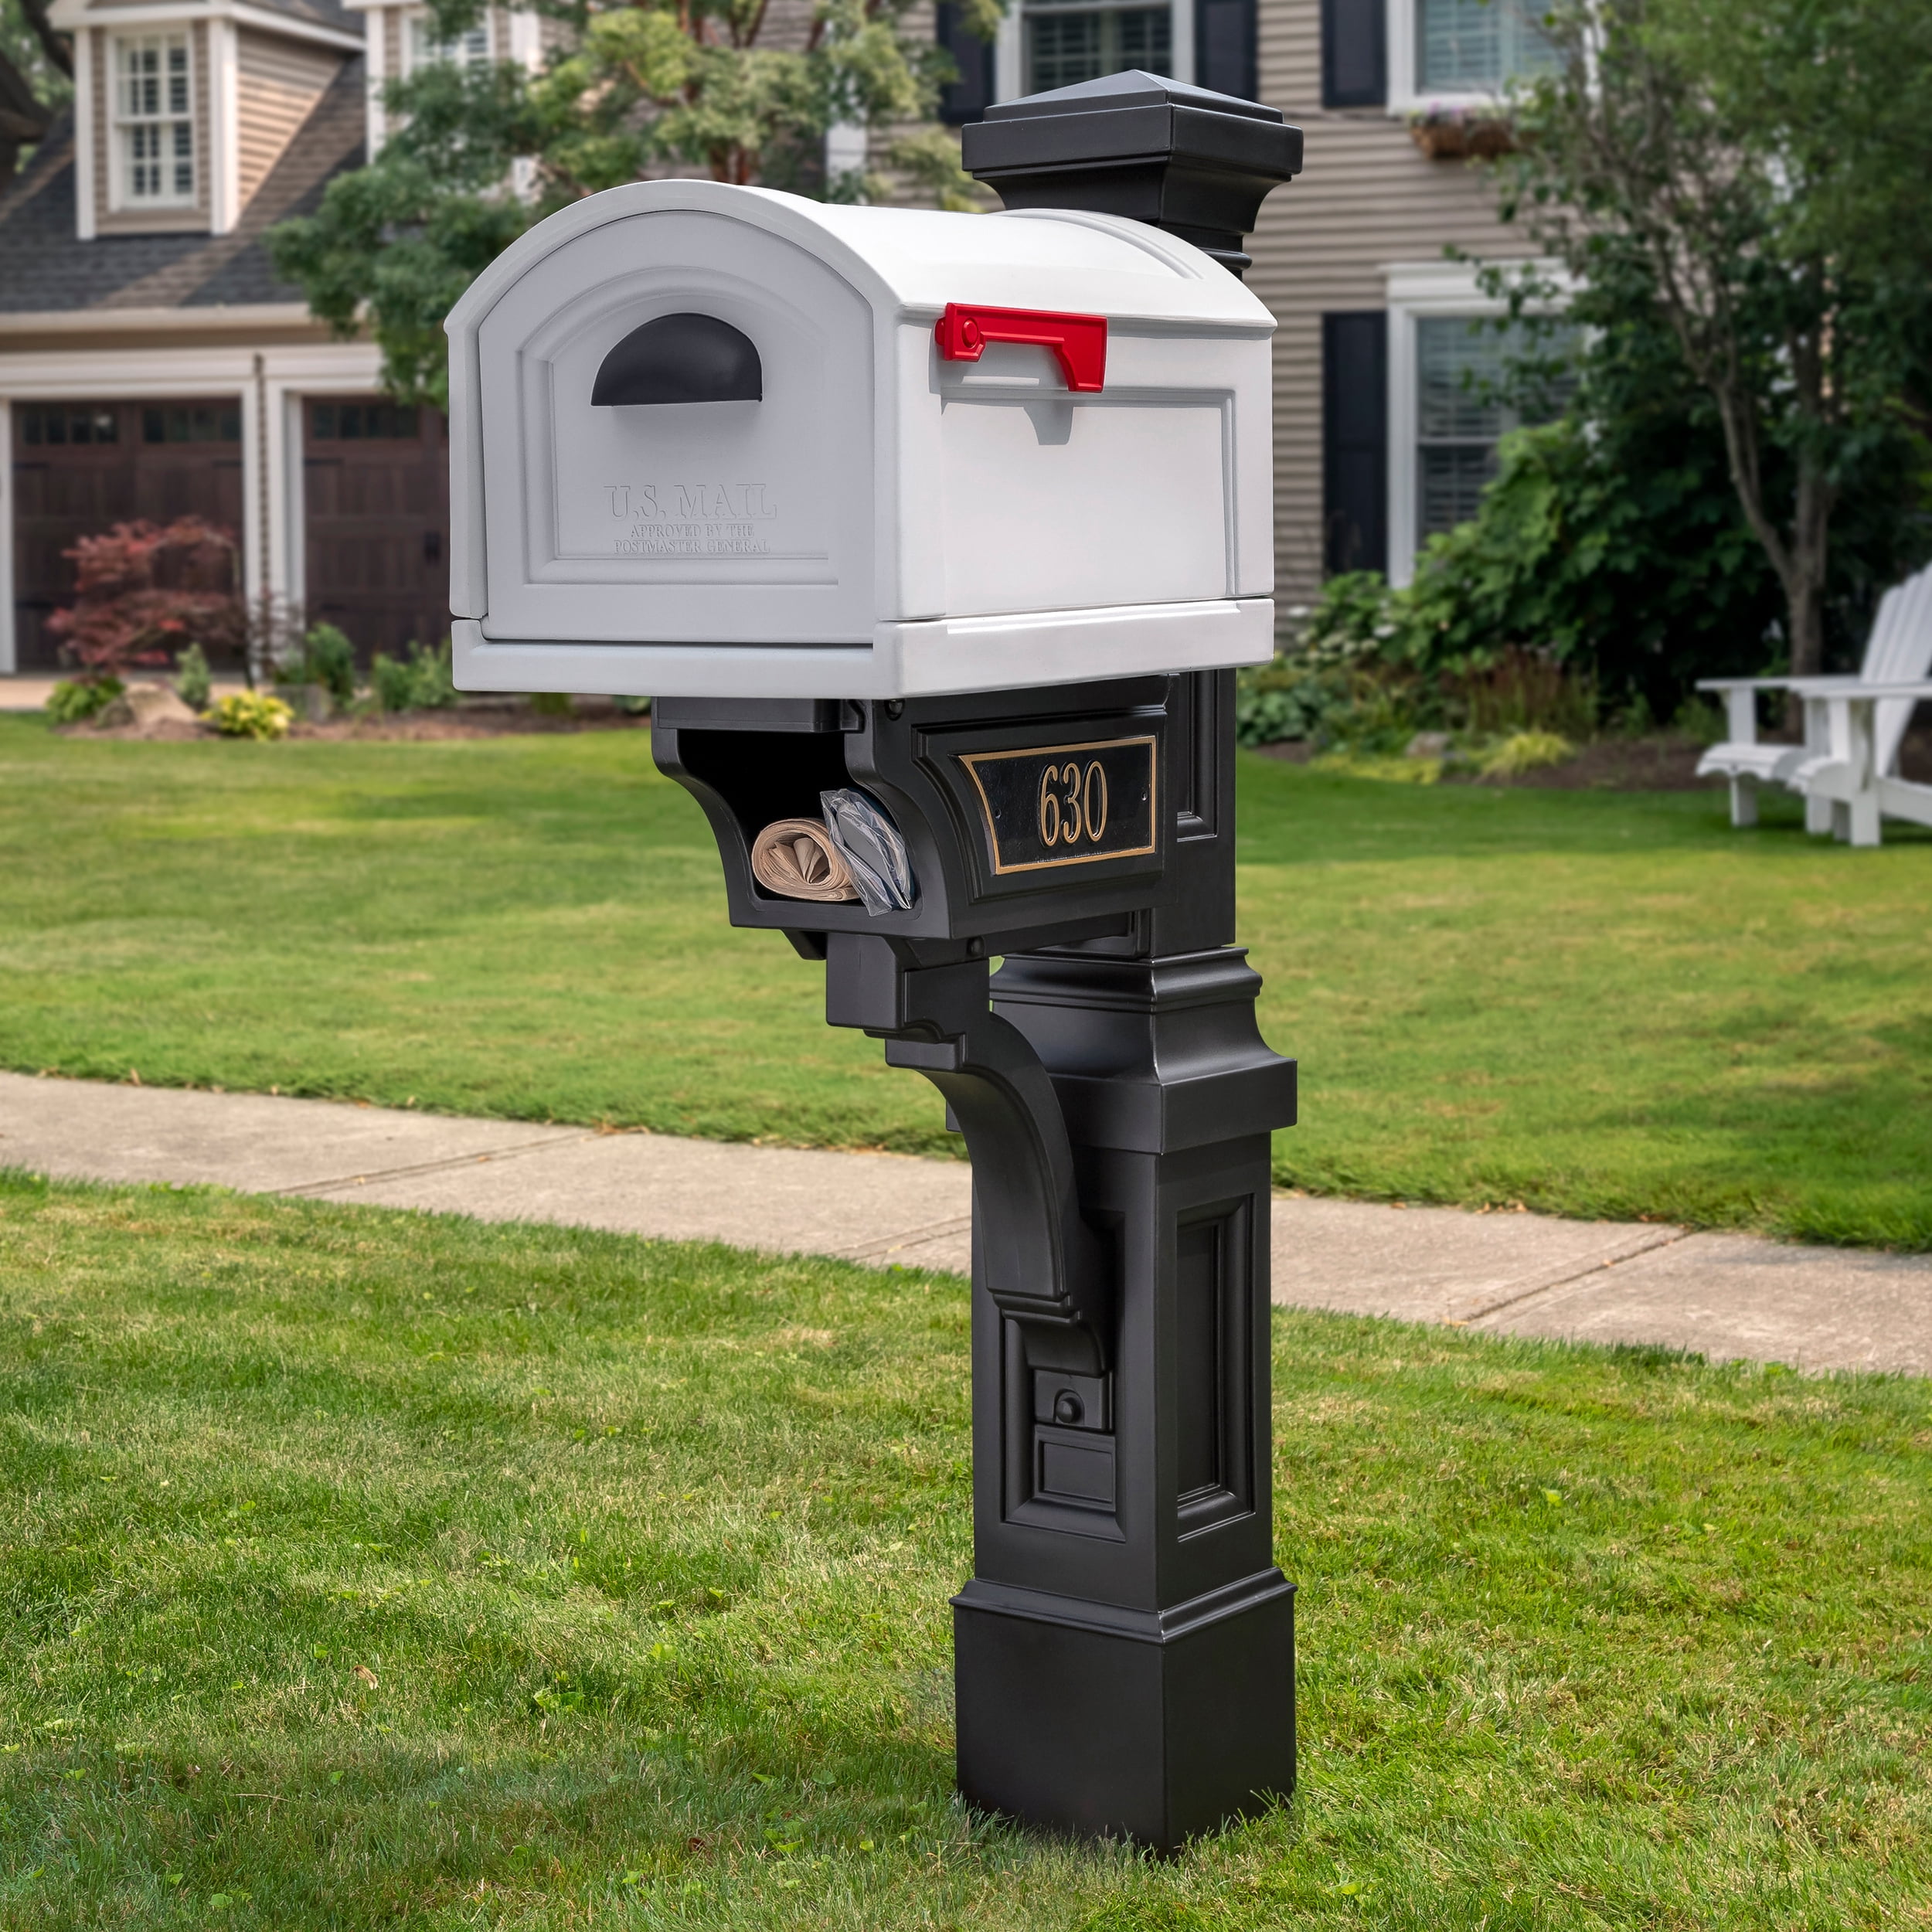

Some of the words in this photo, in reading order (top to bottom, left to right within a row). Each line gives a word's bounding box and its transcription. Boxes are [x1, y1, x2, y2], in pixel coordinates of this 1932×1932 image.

[603, 485, 666, 520] U.S.
[673, 484, 777, 520] MAIL
[631, 524, 701, 538] APPROVED
[705, 524, 723, 538] BY
[726, 523, 755, 537] THE
[614, 539, 702, 554] POSTMASTER
[706, 539, 770, 553] GENERAL
[1039, 760, 1108, 847] 630
